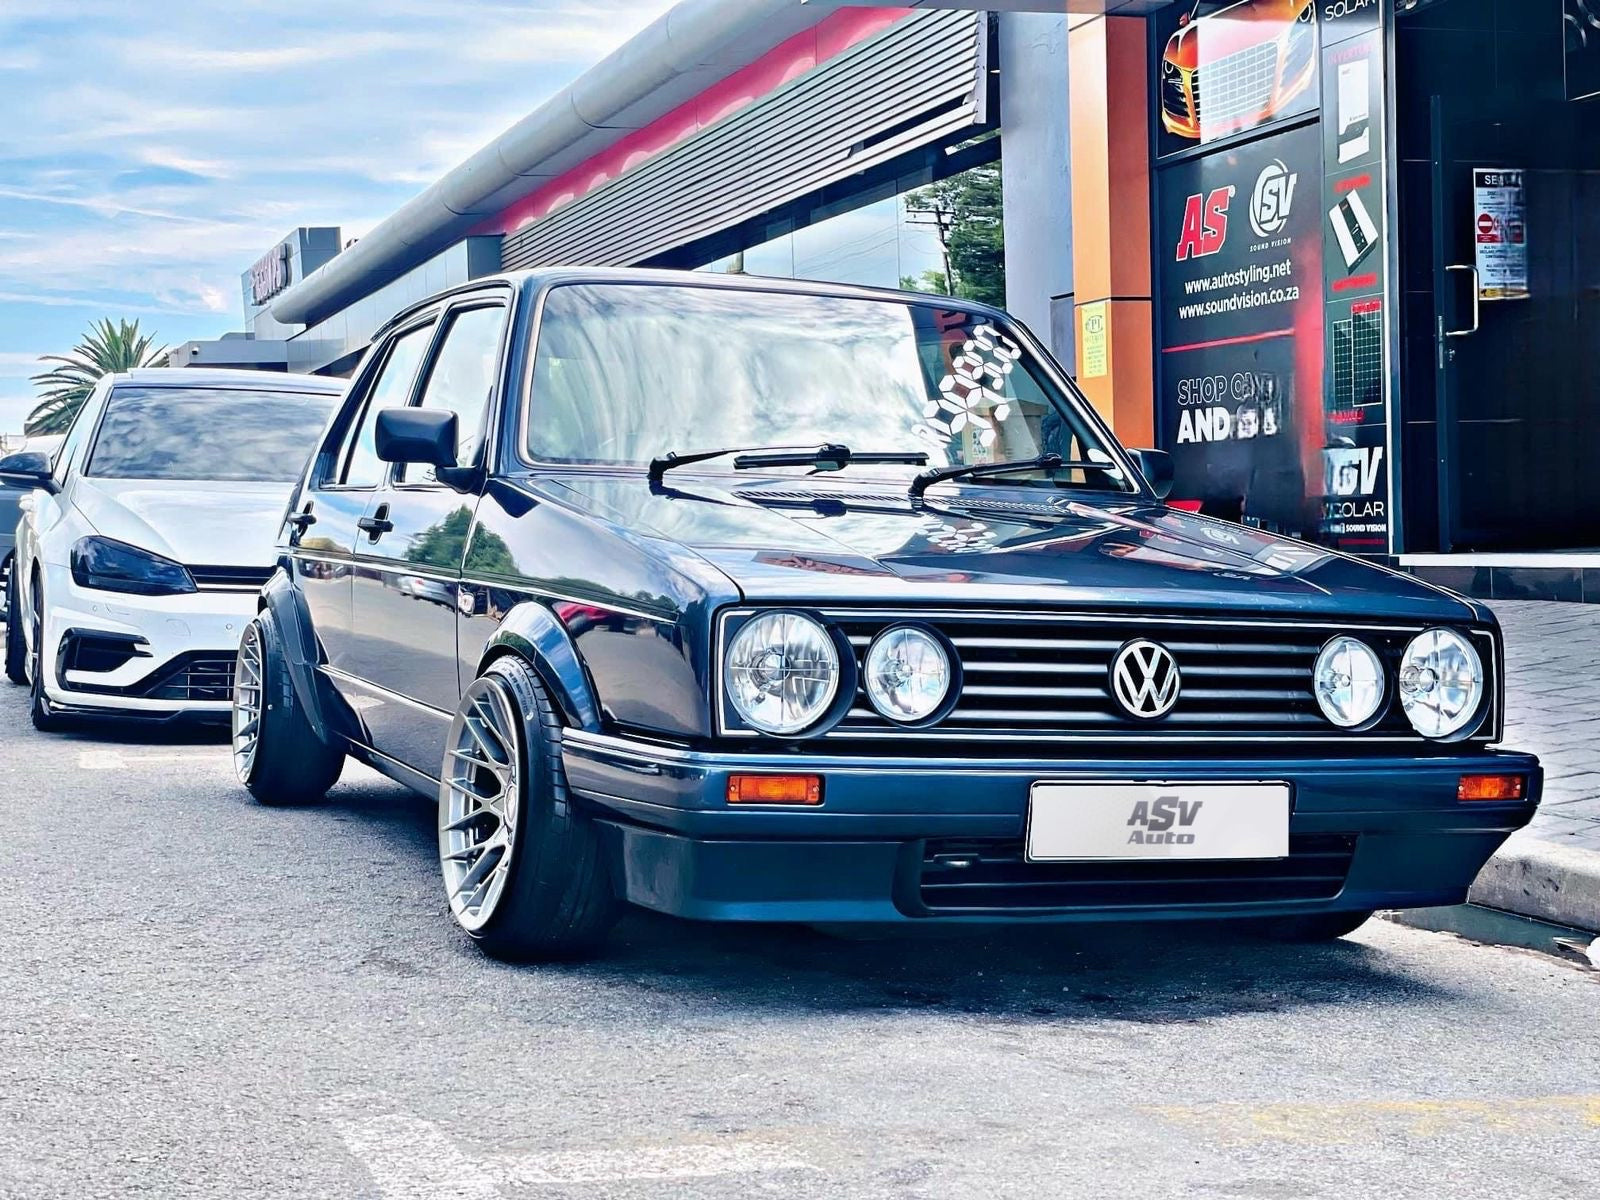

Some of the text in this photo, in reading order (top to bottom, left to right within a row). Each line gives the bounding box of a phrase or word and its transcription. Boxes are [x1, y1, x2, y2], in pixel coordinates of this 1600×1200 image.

[1176, 185, 1231, 261] AS
[1250, 238, 1292, 252] SOUND VISION
[1185, 259, 1291, 294] www.autostyling.net
[1179, 286, 1299, 319] www.soundvision.co.za
[1178, 375, 1227, 405] SHOP
[1177, 407, 1230, 443] AND
[1127, 796, 1203, 831] ASV
[1127, 830, 1195, 845] Auto
